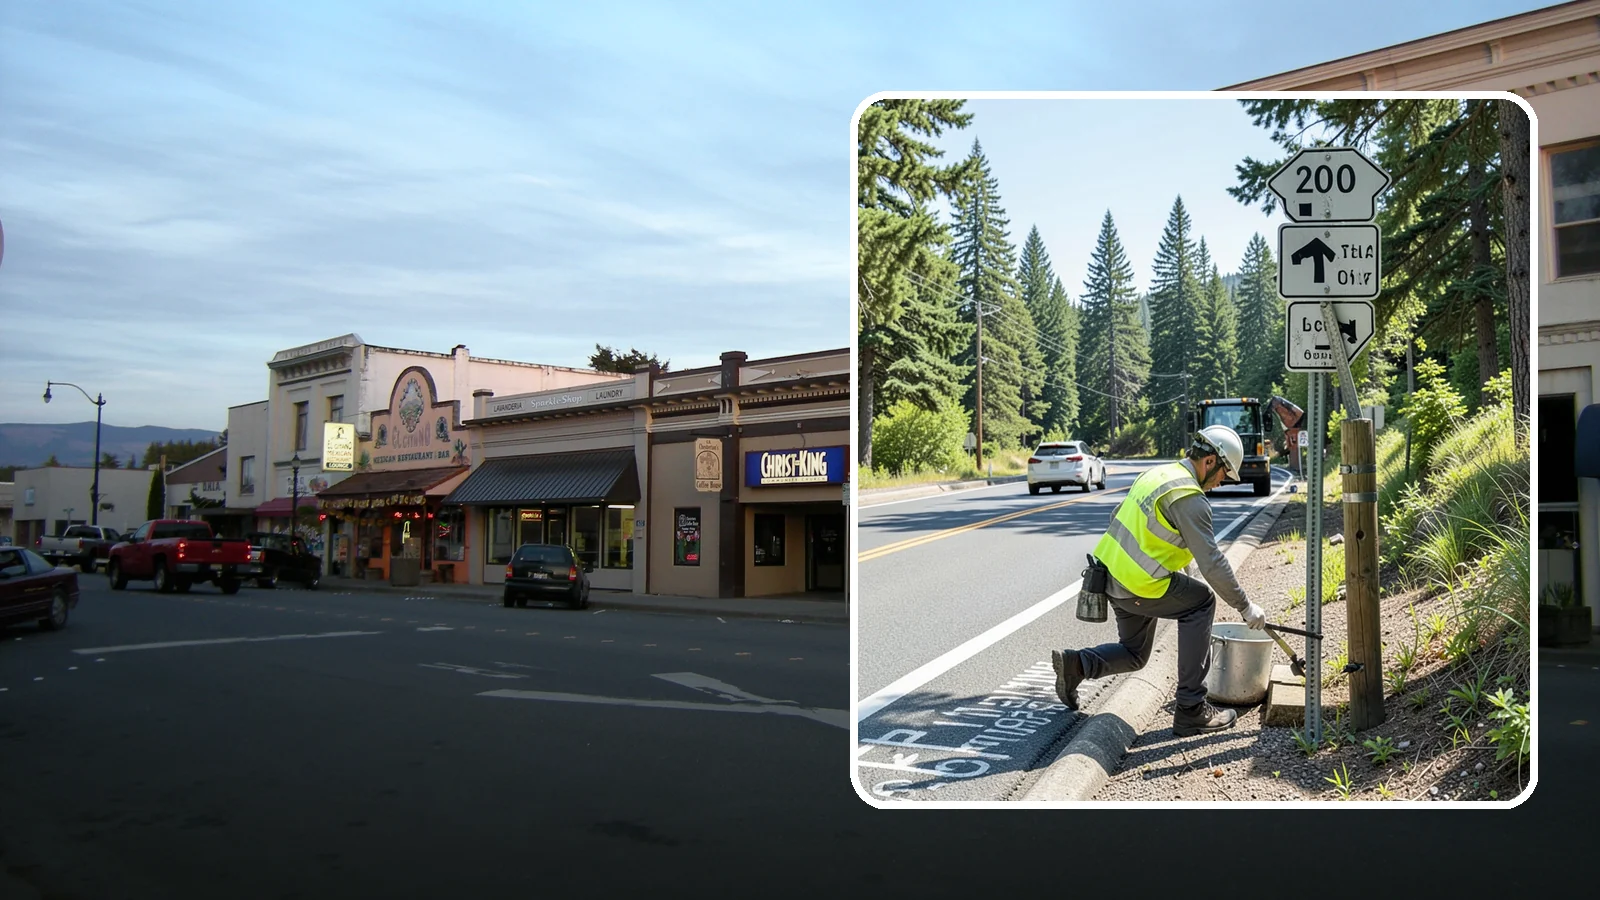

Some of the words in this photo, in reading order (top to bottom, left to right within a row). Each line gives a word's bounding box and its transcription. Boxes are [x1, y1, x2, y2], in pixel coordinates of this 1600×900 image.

[1296, 164, 1356, 194] 200
[595, 389, 623, 400] LAUNDRY
[493, 402, 523, 413] LAVANDERIA
[373, 455, 396, 464] MEXICAN
[397, 451, 433, 462] RESTAURANT
[437, 450, 450, 459] BAR
[761, 452, 797, 478] CHRIST
[799, 450, 827, 476] KING
[696, 480, 709, 489] Coffee
[709, 480, 722, 489] House
